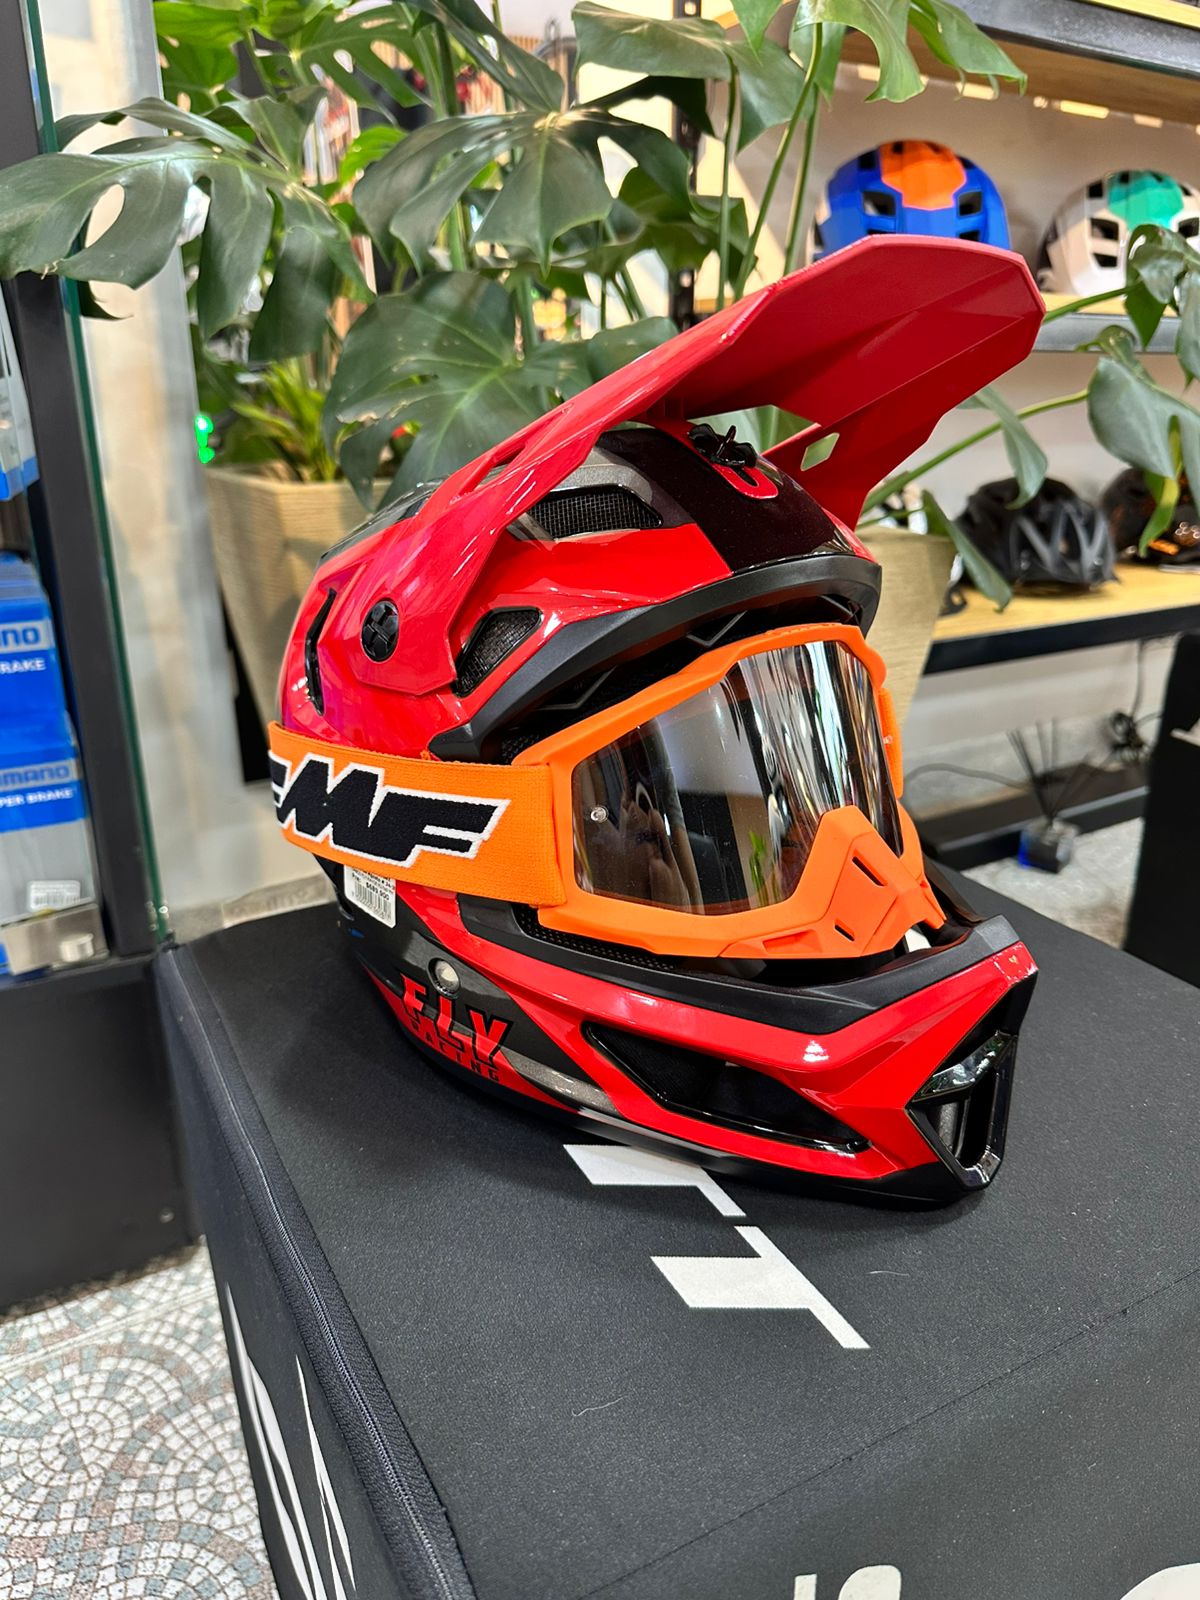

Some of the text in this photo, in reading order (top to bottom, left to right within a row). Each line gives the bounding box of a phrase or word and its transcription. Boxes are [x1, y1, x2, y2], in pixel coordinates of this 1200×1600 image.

[26, 787, 74, 804] BRAKE
[400, 972, 513, 1069] FLY
[408, 1019, 499, 1082] RACING
